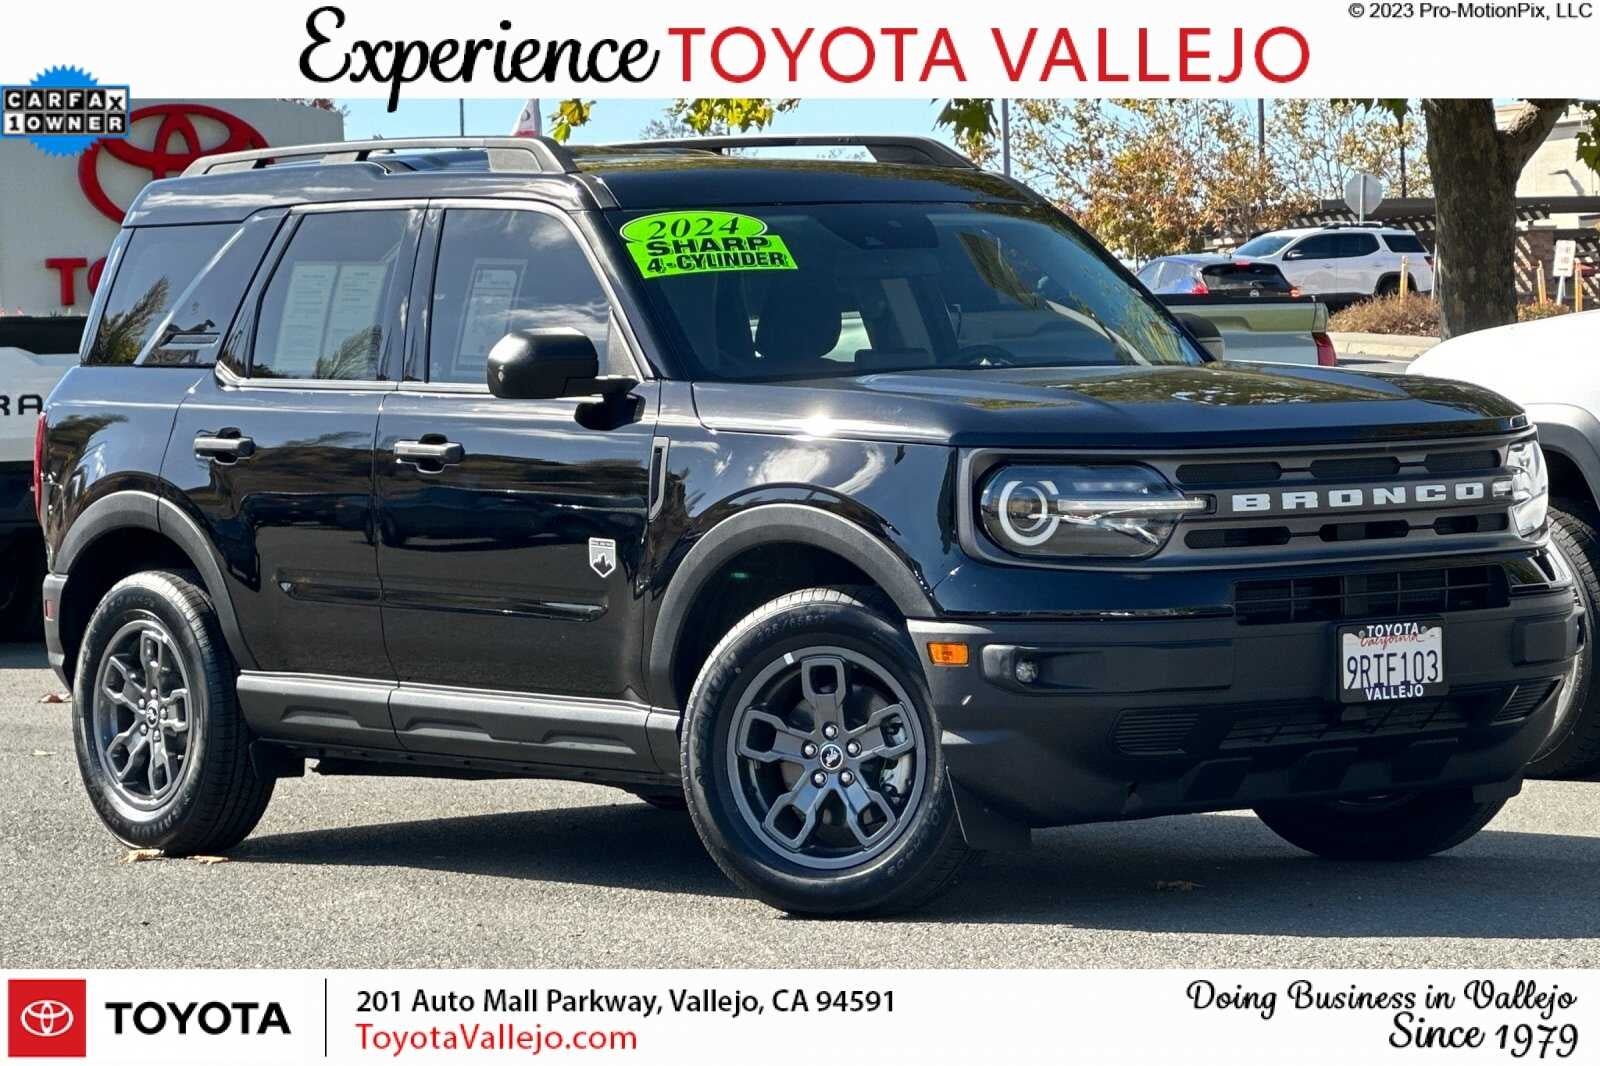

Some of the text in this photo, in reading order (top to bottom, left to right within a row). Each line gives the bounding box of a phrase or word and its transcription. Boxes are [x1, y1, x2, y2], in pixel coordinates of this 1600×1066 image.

[649, 216, 740, 241] 2024
[646, 236, 771, 257] SHARP
[647, 251, 788, 274] 4-CYLINDER
[1232, 482, 1484, 512] BRONCO
[1366, 622, 1420, 637] TOYOTA
[1365, 683, 1425, 701] VALLEJO
